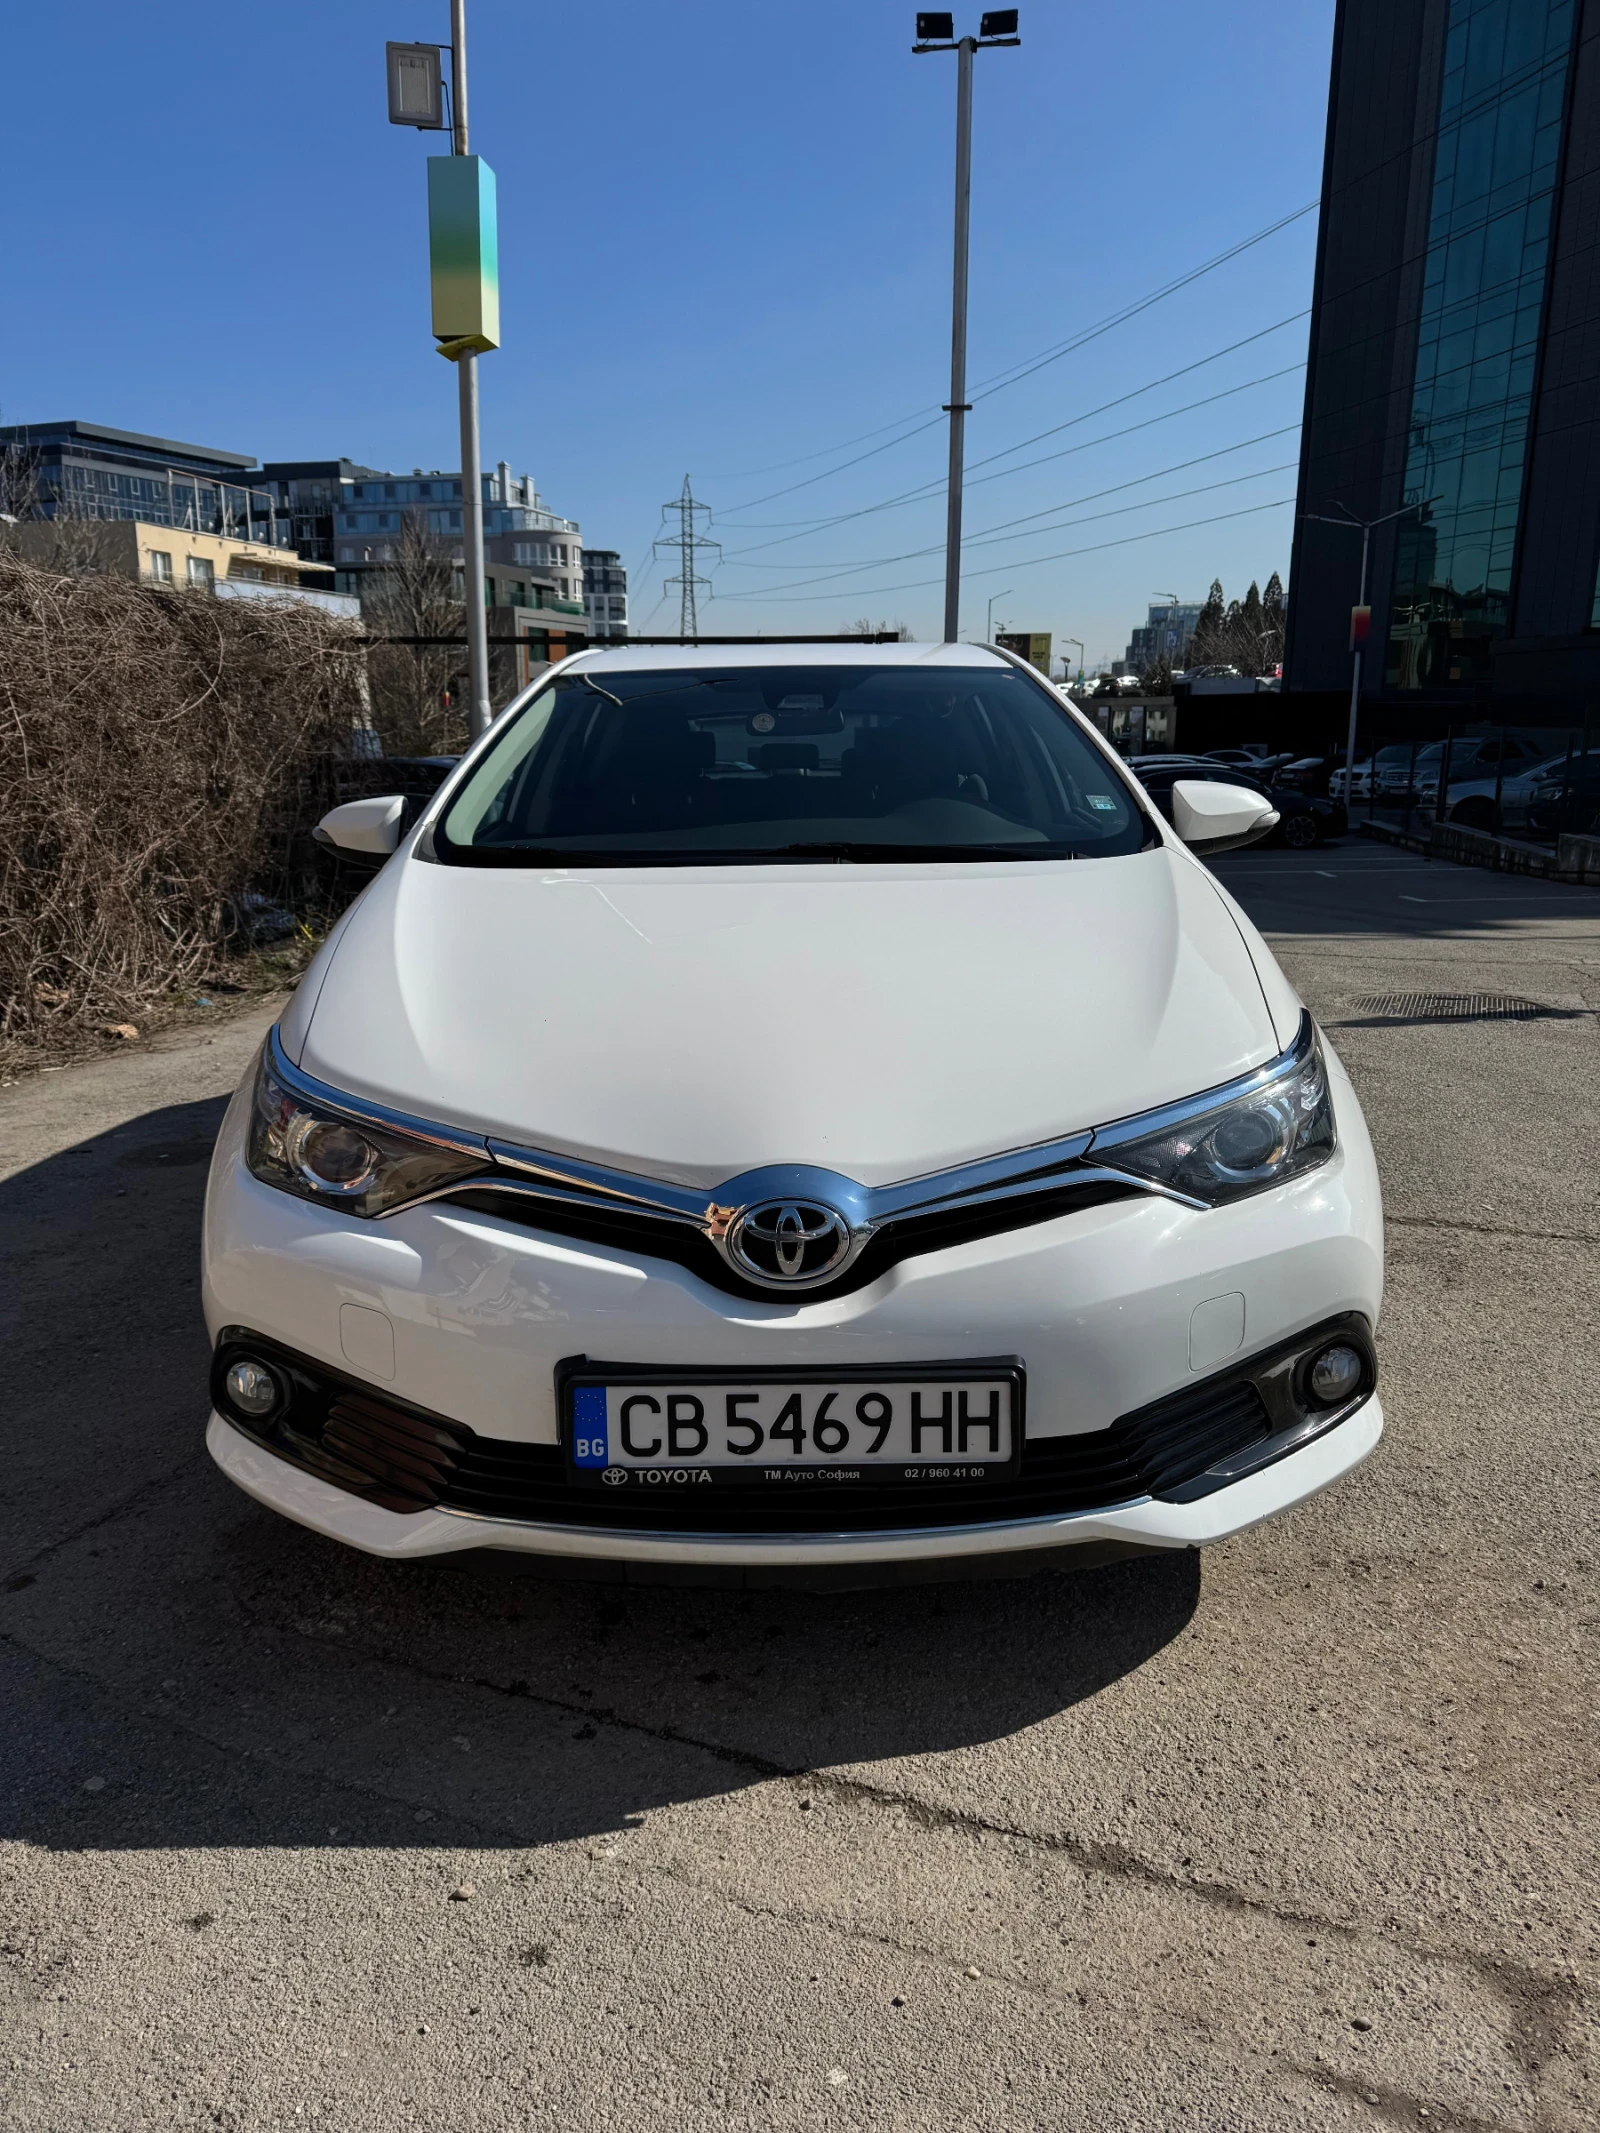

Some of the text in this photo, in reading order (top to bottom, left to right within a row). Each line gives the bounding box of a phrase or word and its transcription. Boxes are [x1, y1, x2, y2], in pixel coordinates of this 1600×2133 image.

[619, 1390, 1000, 1457] CB 5469 HH
[576, 1438, 605, 1457] BG
[635, 1469, 713, 1484] TOYOTA
[784, 1470, 814, 1482] Ауто
[817, 1469, 860, 1482] София
[904, 1468, 919, 1478] 02
[928, 1468, 950, 1478] 960
[952, 1467, 967, 1478] 41
[970, 1467, 985, 1478] 00
